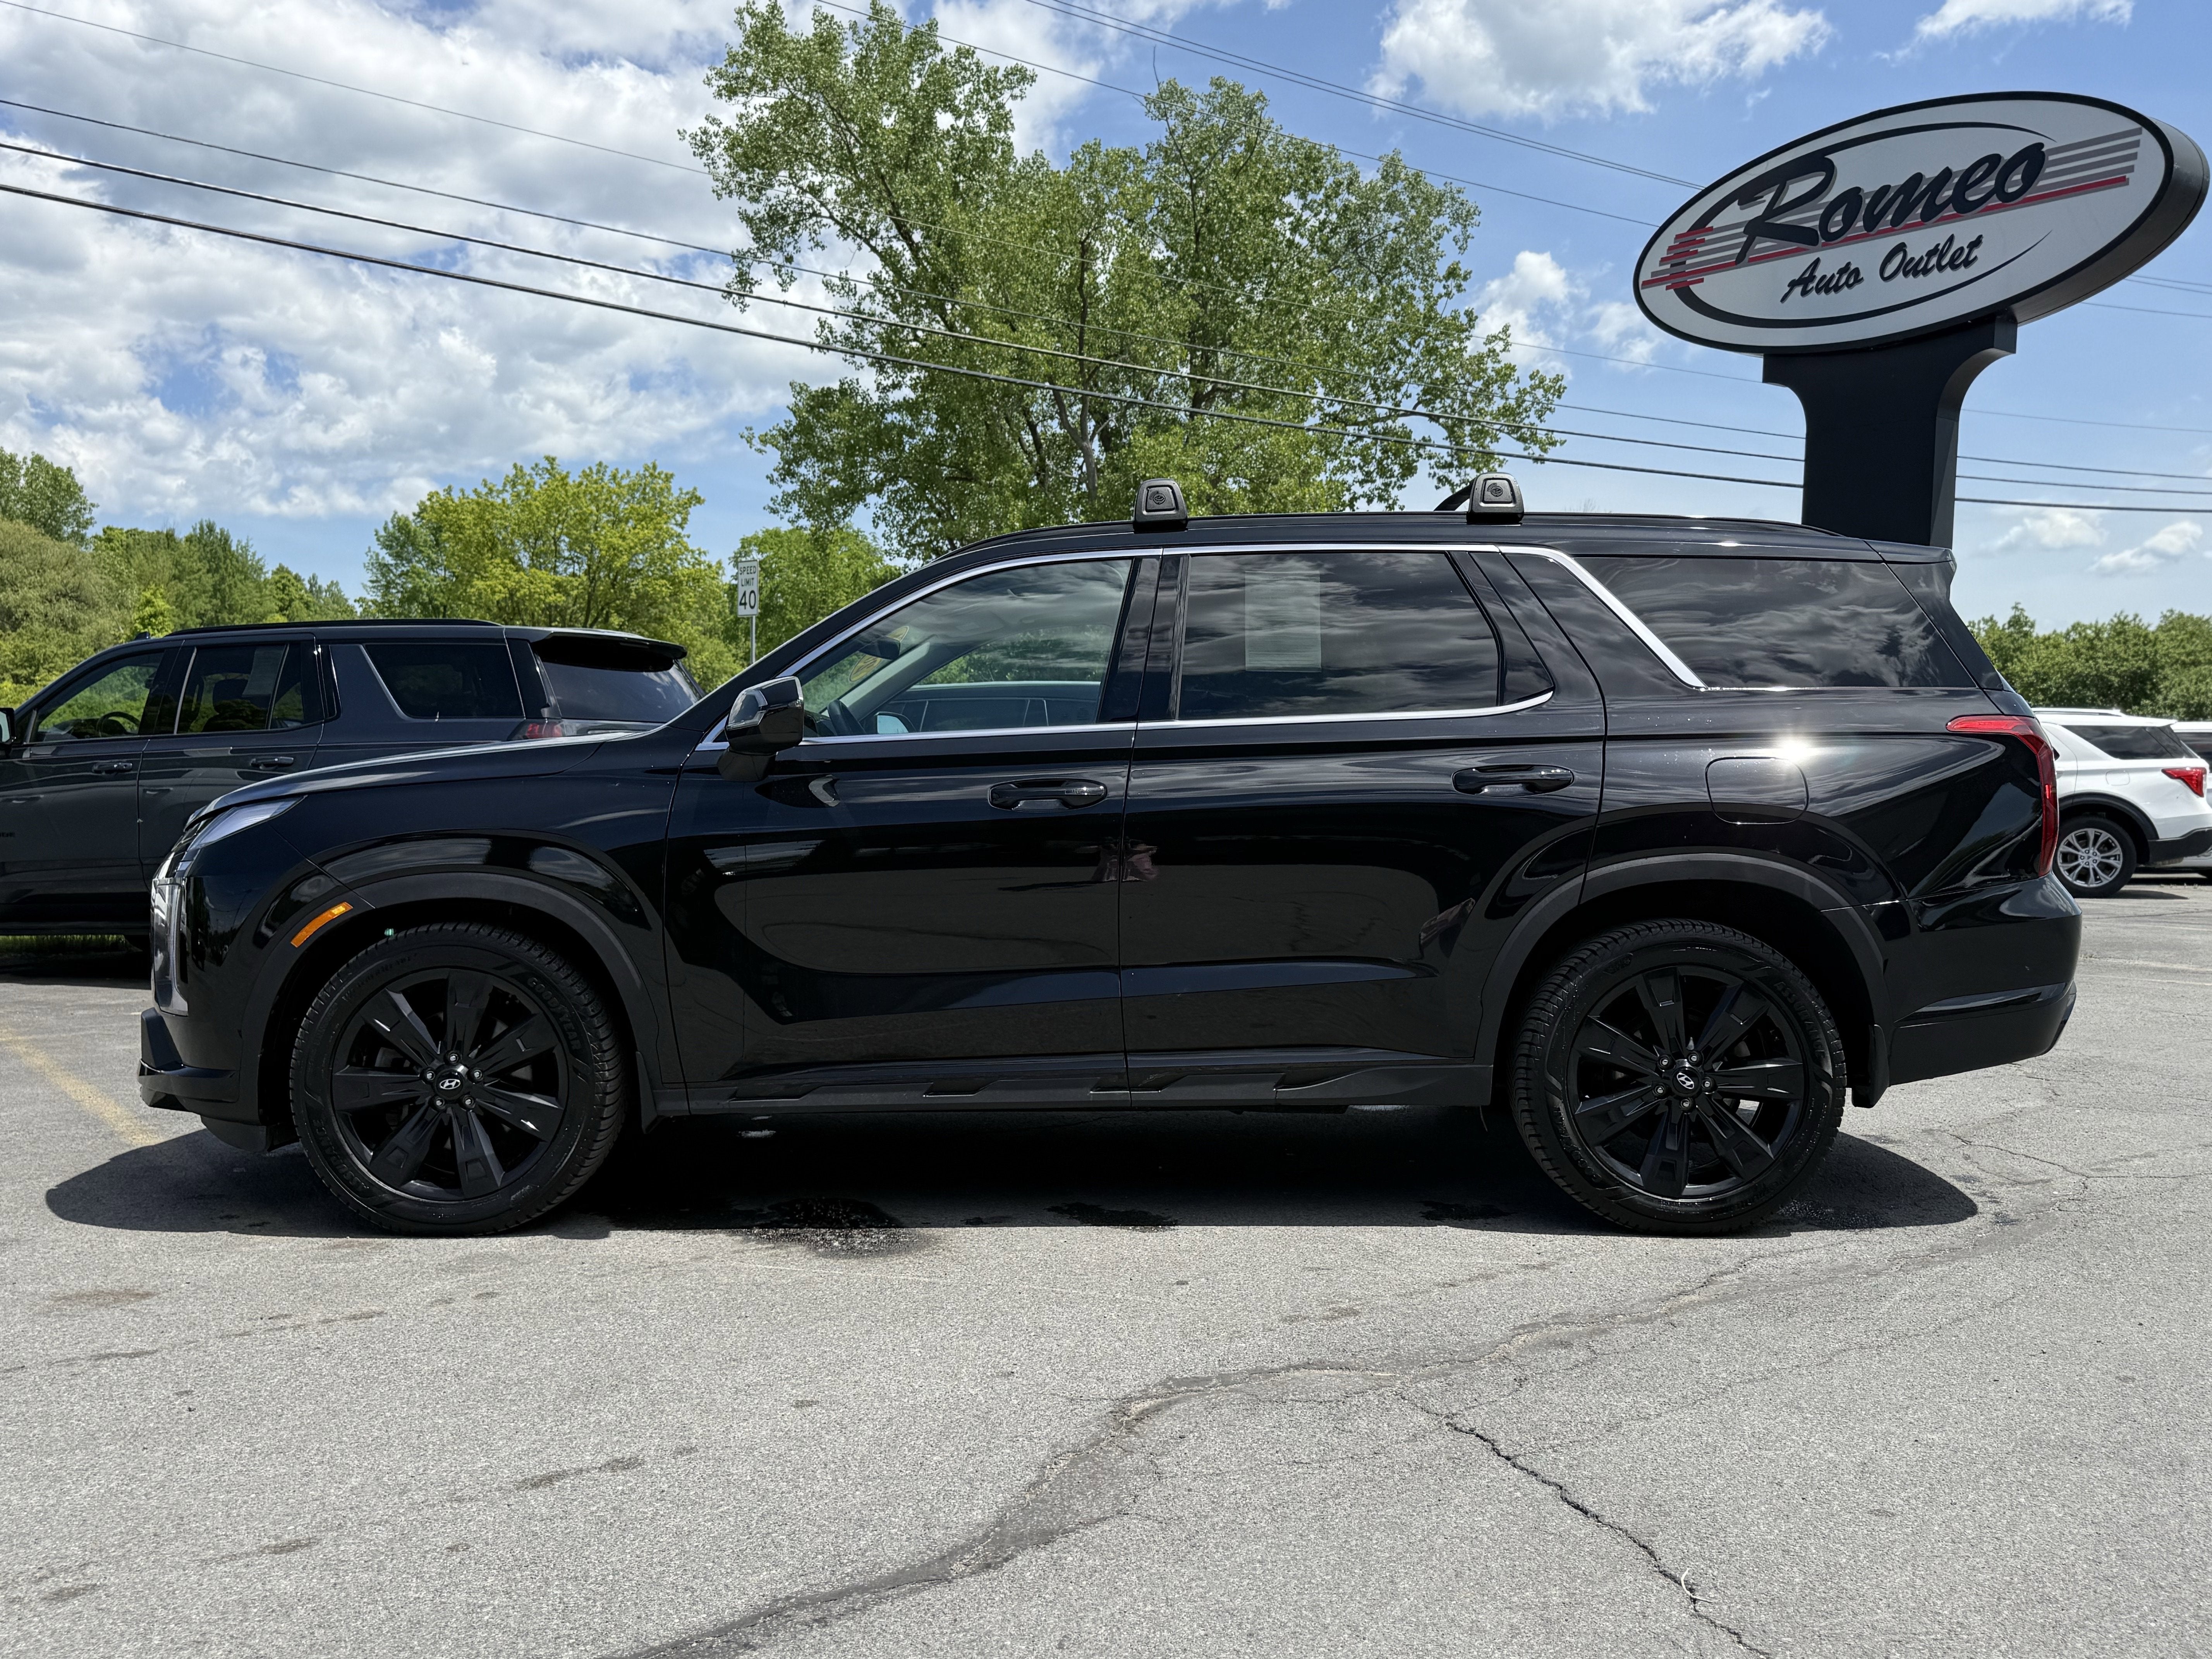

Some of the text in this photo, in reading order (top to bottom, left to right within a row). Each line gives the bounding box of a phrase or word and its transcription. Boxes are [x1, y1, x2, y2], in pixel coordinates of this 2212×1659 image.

[1733, 142, 2046, 265] Romeo
[1780, 234, 1983, 304] Auto Outlet
[740, 566, 756, 575] SPEED
[741, 578, 754, 586] LIMIT
[739, 590, 756, 609] 40
[527, 977, 582, 1050] GOODYEAR
